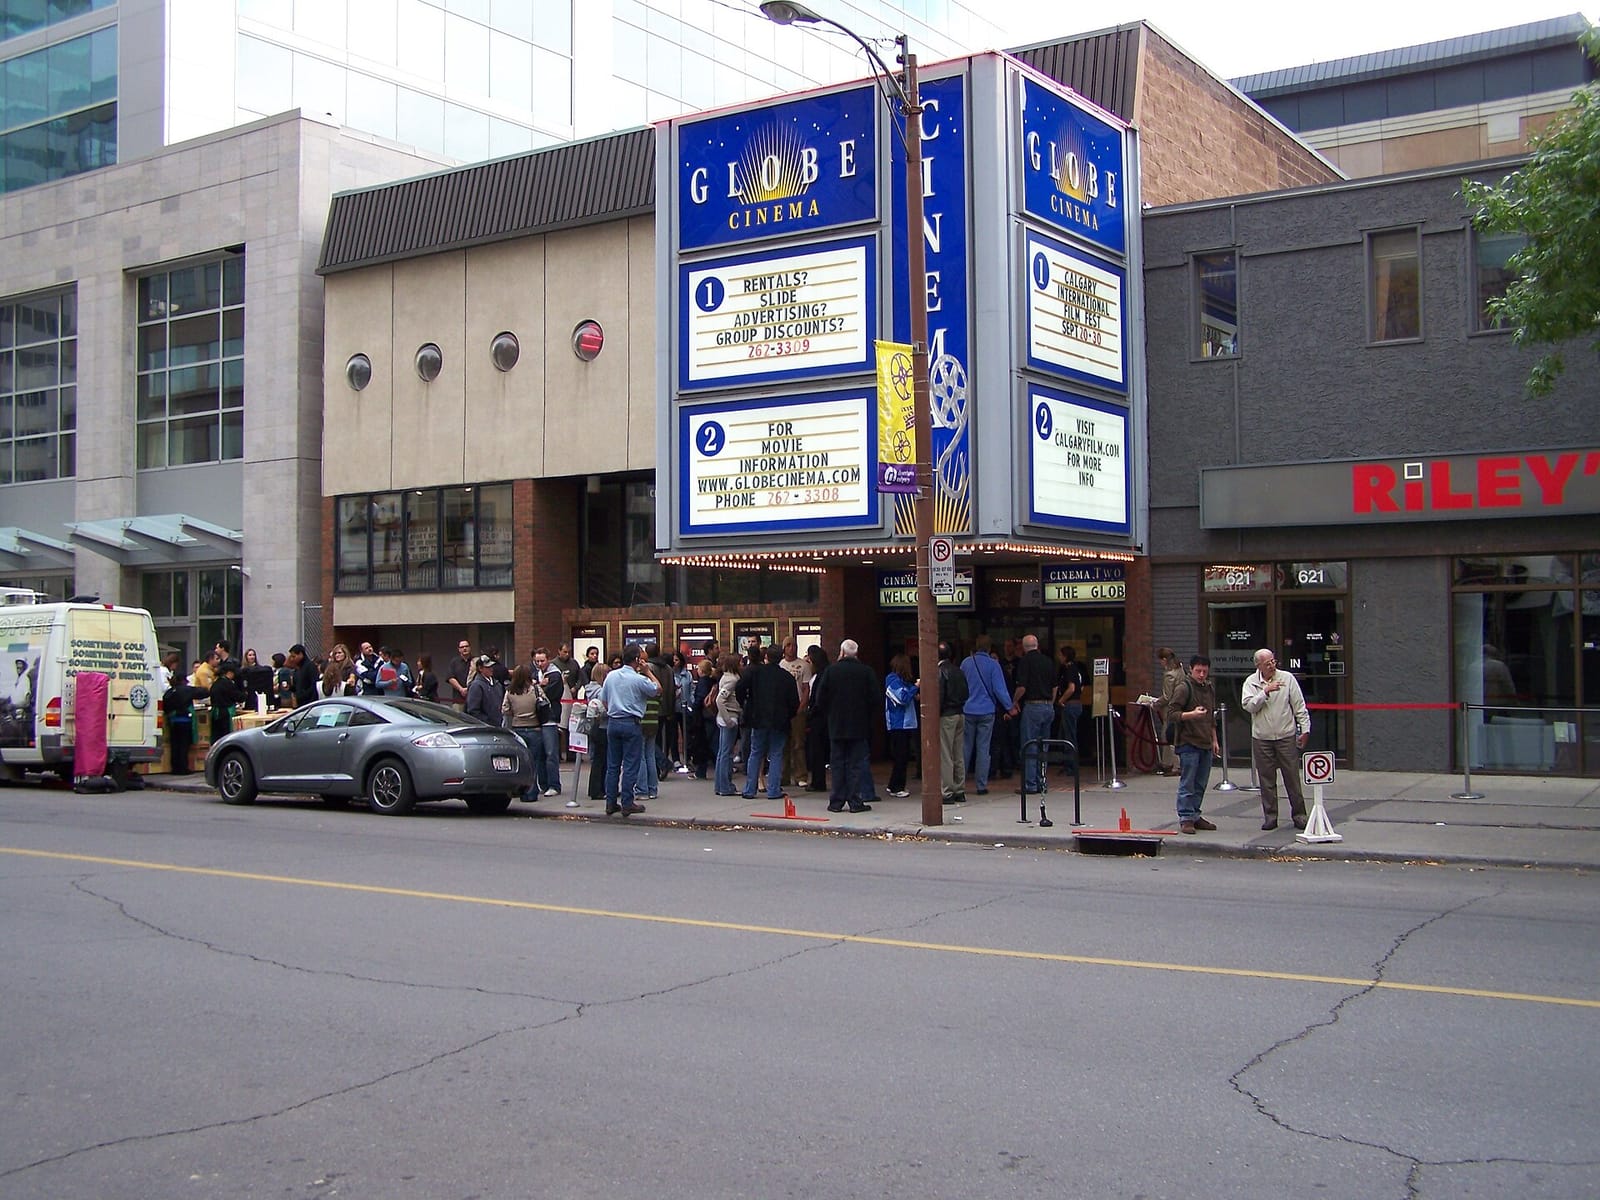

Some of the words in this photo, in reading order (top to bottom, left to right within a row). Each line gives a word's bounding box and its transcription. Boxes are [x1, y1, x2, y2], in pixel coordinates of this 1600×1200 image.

[690, 140, 856, 204] GLOBE
[1027, 131, 1116, 208] GLOBE
[729, 200, 819, 229] CINEMA
[1051, 195, 1098, 231] CINEMA
[744, 272, 808, 293] RENTALS?
[1064, 271, 1097, 294] CALGARY
[704, 282, 715, 308] 1
[760, 290, 797, 307] SLIDE
[1057, 285, 1110, 316] INTERNATIONAL
[734, 303, 827, 327] ADVERTISING?
[1064, 304, 1081, 322] FILM
[1085, 312, 1101, 329] FEST
[716, 329, 757, 345] GROUP
[764, 318, 844, 340] DISCOUNTS?
[1062, 320, 1078, 338] SEPT
[768, 422, 793, 437] FOR
[1077, 419, 1095, 436] VISIT
[704, 426, 717, 451] 2
[762, 439, 802, 454] MOVIE
[1055, 432, 1120, 458] CALGARYFILM.COM
[740, 453, 828, 473] INFORMATION
[1067, 452, 1081, 468] FOR
[1083, 456, 1102, 471] MORE
[698, 468, 861, 493] WWW.GLOBECINEMA.COM
[1079, 471, 1094, 487] INFO
[715, 492, 756, 508] PHONE
[884, 576, 917, 585] CINEM
[1050, 570, 1090, 580] CINEMA
[1094, 568, 1121, 579] TWO
[1226, 572, 1250, 585] 621
[1298, 570, 1324, 583] 621
[884, 591, 918, 603] WELCO
[1056, 586, 1078, 599] THE
[1091, 585, 1126, 598] GLOB
[71, 640, 121, 650] SOMETHING
[69, 659, 119, 669] SOMETHING
[1290, 658, 1301, 668] IN
